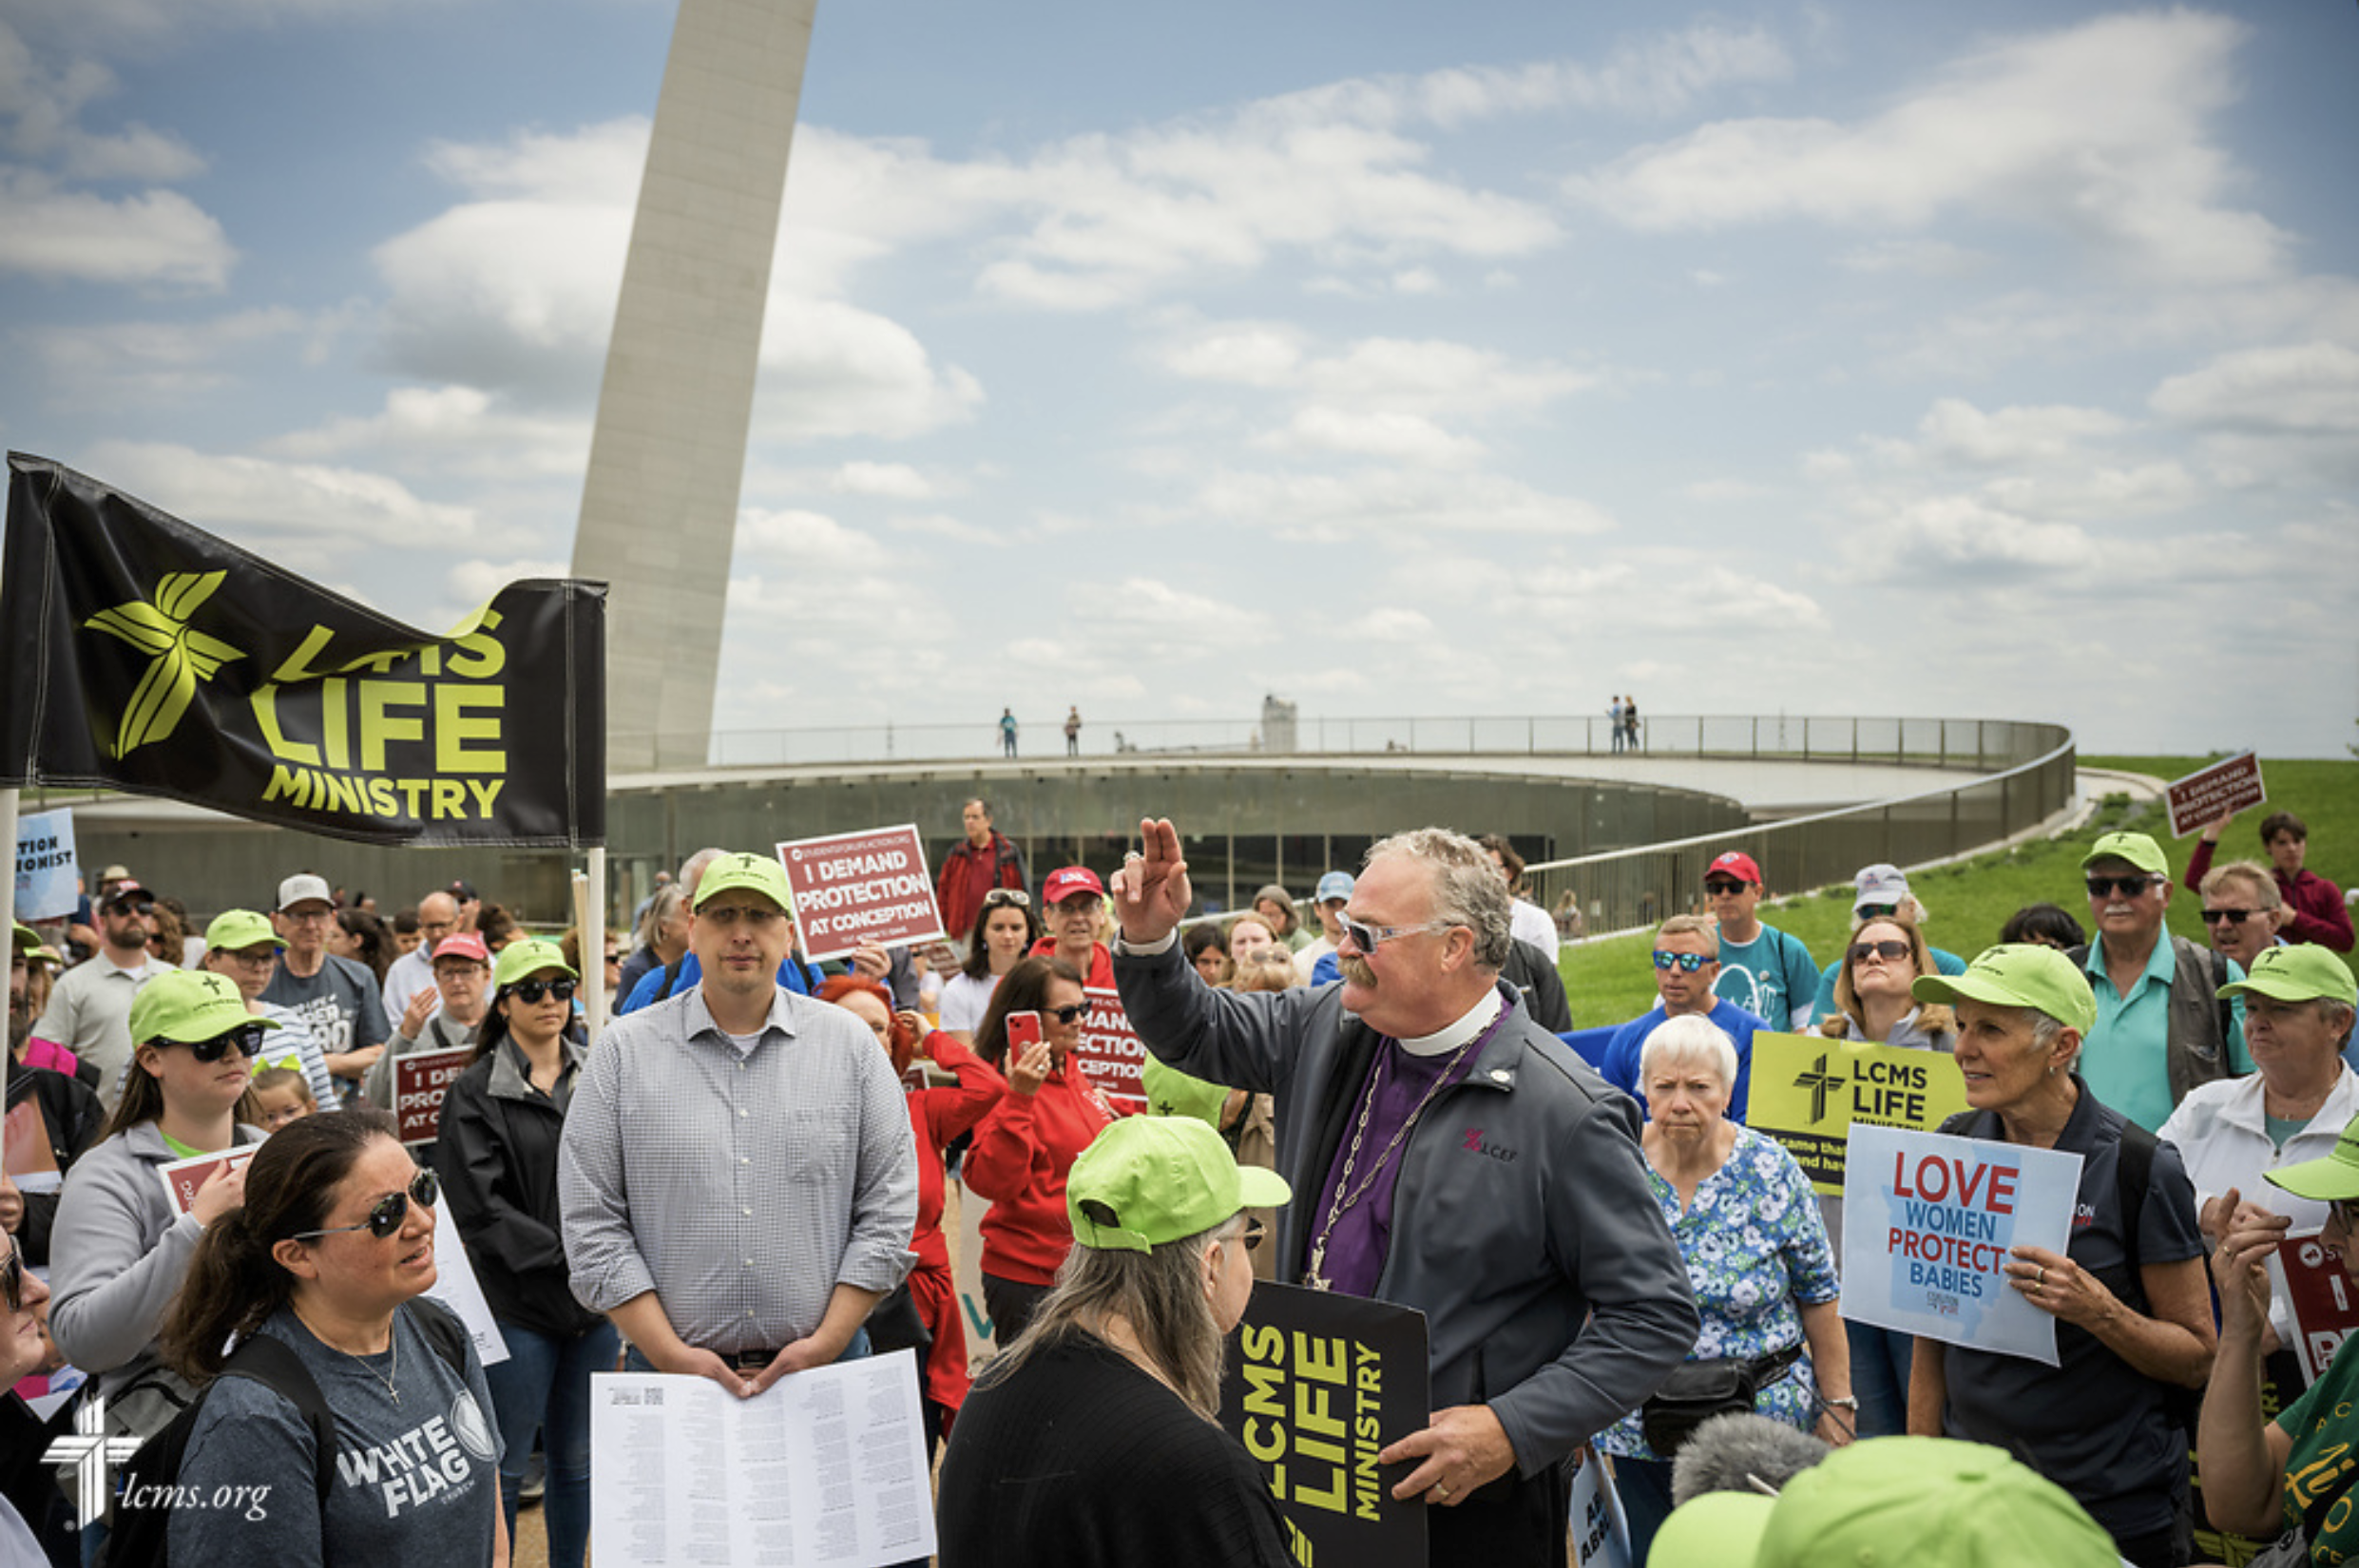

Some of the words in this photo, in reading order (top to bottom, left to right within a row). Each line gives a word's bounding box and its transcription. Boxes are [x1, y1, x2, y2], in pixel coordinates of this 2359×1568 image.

[250, 678, 507, 774] LIFE
[261, 763, 506, 819] MINISTRY
[804, 863, 814, 884] I
[818, 850, 908, 882] DEMAND
[796, 872, 929, 912] PROTECTION
[809, 918, 830, 936] AT
[832, 900, 931, 931] CONCEPTION
[1853, 1060, 1927, 1090] LCMS
[404, 1114, 428, 1129] AT
[1853, 1085, 1927, 1122] LIFE
[1894, 1152, 2020, 1214] LOVE
[1905, 1200, 1997, 1242] WOMEN
[1889, 1227, 2006, 1275] PROTECT
[1909, 1262, 1983, 1298] BABIES
[1240, 1324, 1287, 1501] LCMS
[1293, 1331, 1348, 1515] LIFE
[1353, 1340, 1382, 1522] MINISTRY
[336, 1415, 456, 1488] WHITE
[382, 1448, 470, 1519] FLAG
